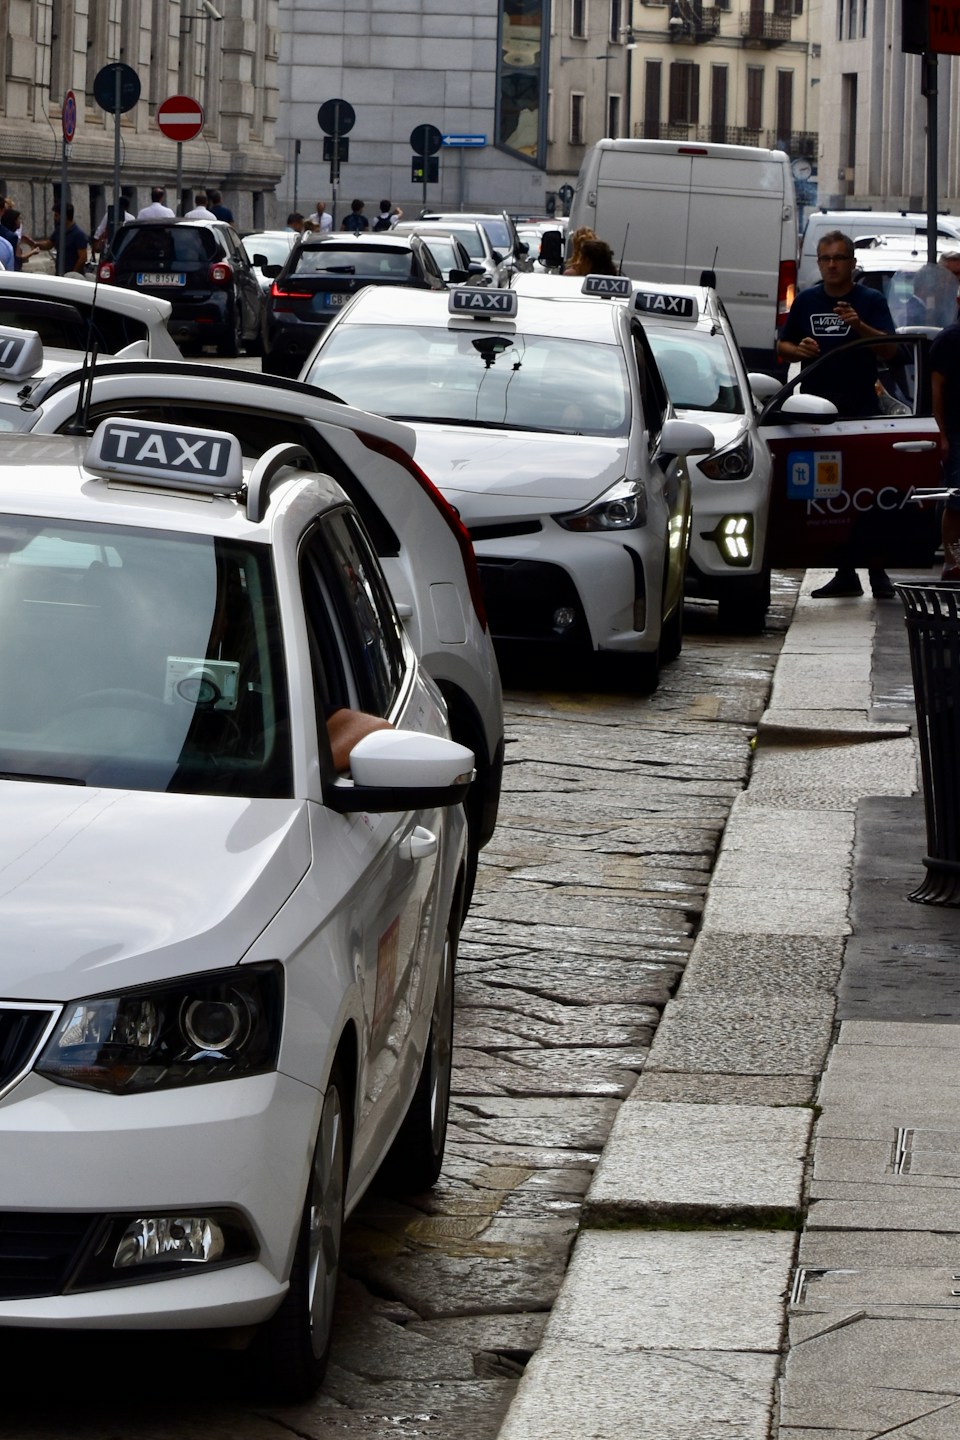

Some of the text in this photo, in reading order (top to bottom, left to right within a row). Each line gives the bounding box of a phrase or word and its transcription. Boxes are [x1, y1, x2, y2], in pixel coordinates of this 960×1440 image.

[932, 4, 960, 35] TAX
[590, 278, 627, 294] TAXI
[457, 292, 509, 309] TAXI
[643, 293, 687, 314] TAXI
[109, 427, 222, 472] TAXI
